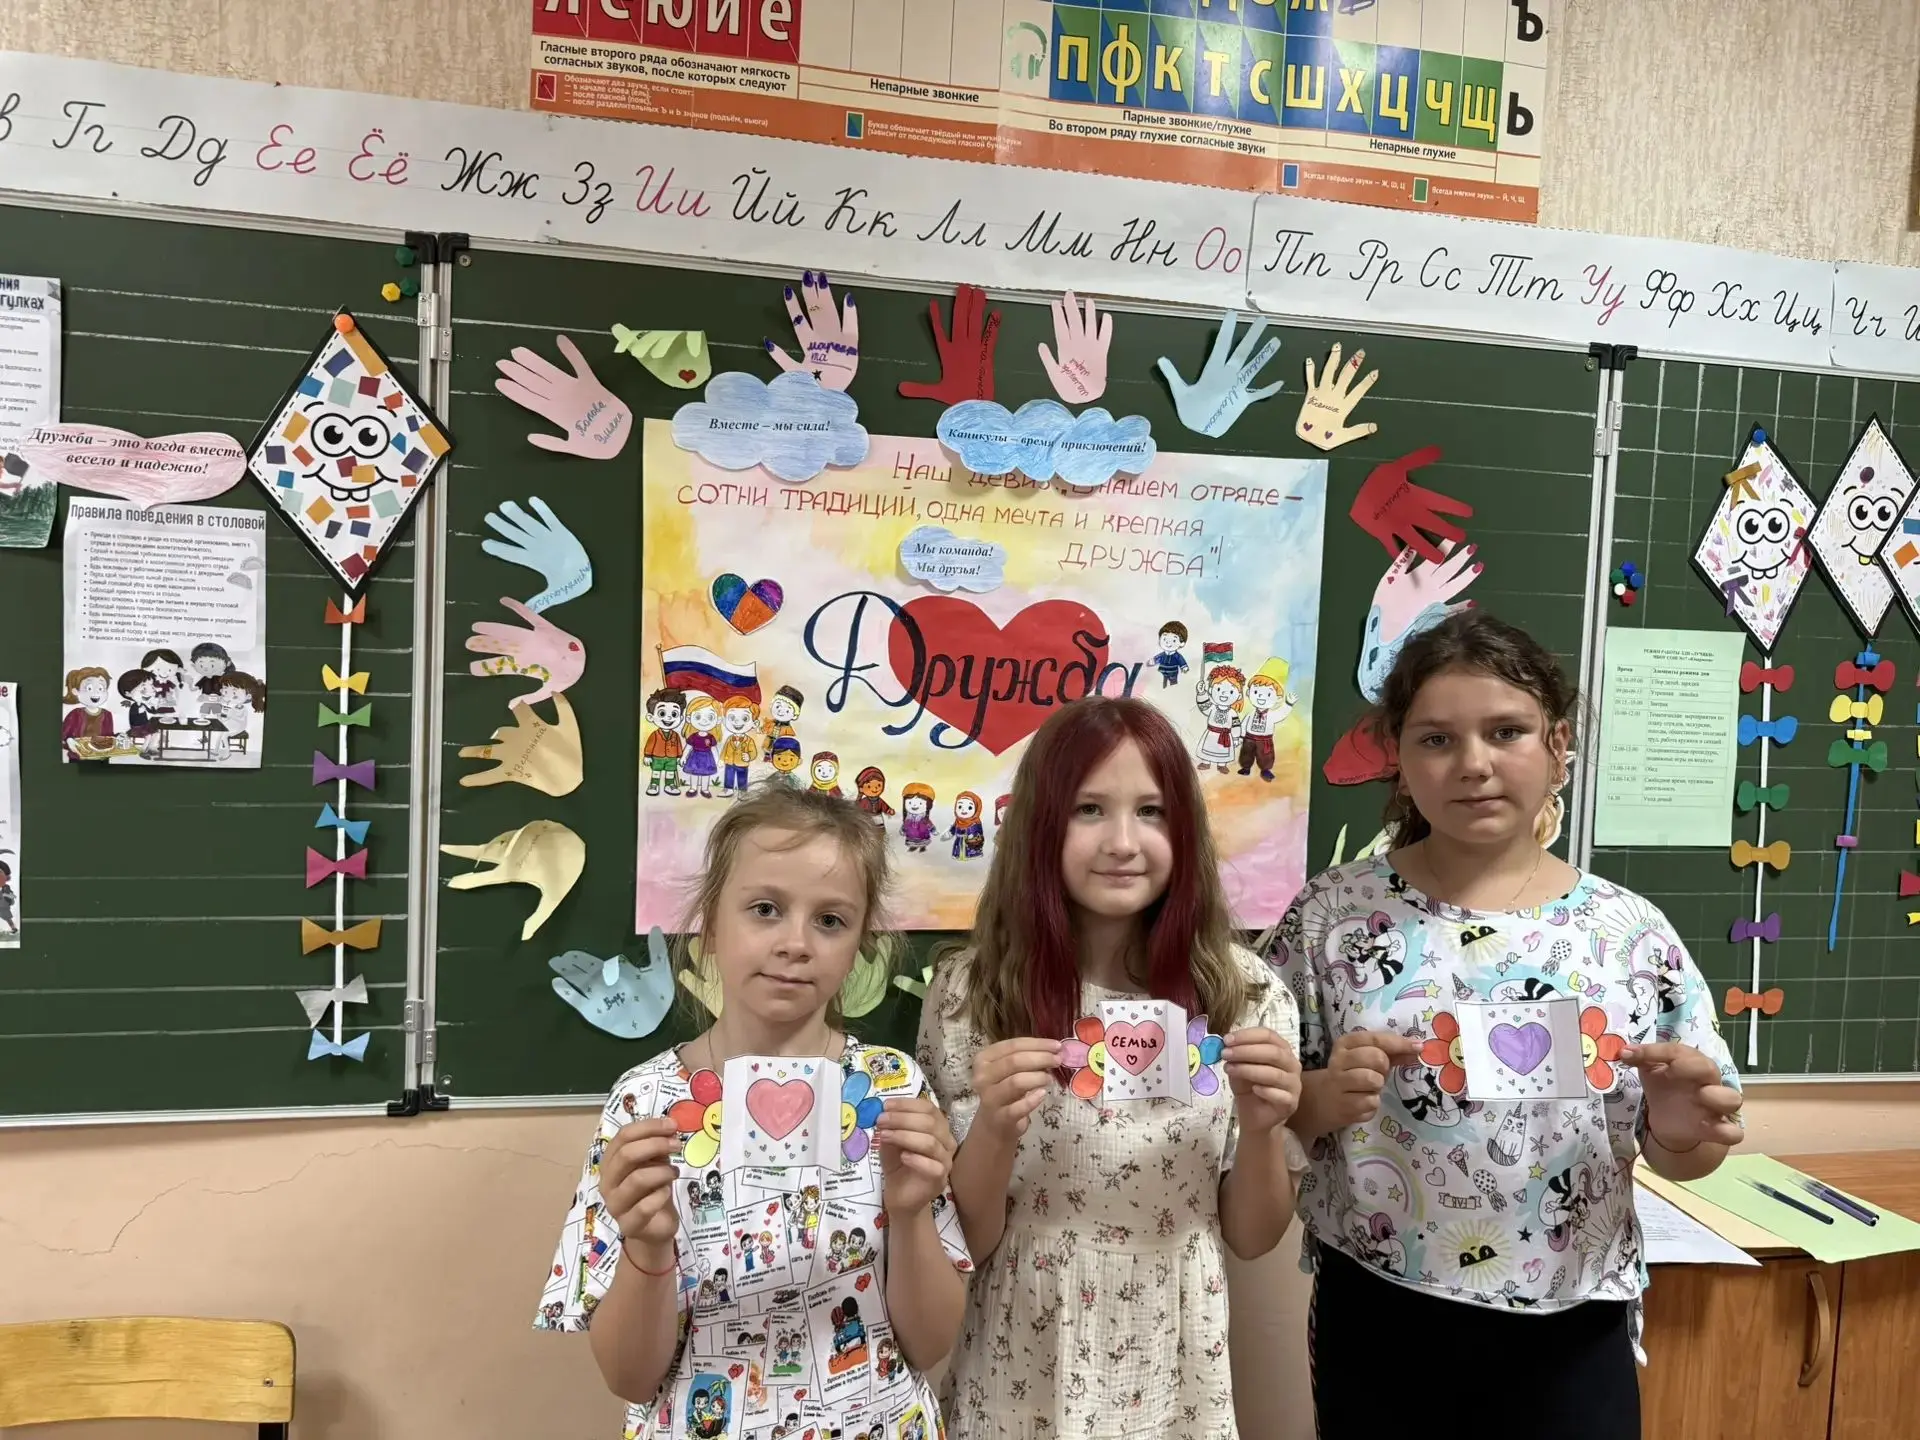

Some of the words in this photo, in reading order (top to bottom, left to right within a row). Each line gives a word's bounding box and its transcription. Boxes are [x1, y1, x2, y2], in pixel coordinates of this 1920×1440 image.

[540, 40, 588, 56] Гласные
[591, 48, 636, 61] второго
[640, 54, 667, 66] ряда
[670, 57, 738, 74] обозначают
[740, 66, 791, 81] мягкость
[544, 55, 603, 69] согласных
[606, 61, 649, 75] звуков,
[651, 68, 685, 79] после
[688, 72, 736, 85] которых
[739, 78, 786, 92] следуют
[564, 75, 609, 85] Обозначают
[651, 85, 670, 93] если
[573, 92, 594, 100] после
[596, 94, 625, 103] гласной
[573, 98, 594, 108] после
[608, 88, 629, 96] слова
[870, 78, 929, 98] Непарные
[932, 89, 979, 103] звонкие
[1123, 111, 1166, 125] Парные
[1169, 116, 1252, 136] звонкие/глухие
[1049, 119, 1063, 131] Во
[1066, 123, 1107, 137] втором
[1110, 127, 1137, 141] ряду
[1140, 130, 1177, 144] глухие
[1180, 134, 1235, 149] согласные
[1237, 142, 1266, 155] звуки
[1369, 138, 1420, 156] Непарные
[1422, 147, 1457, 160] глухие
[52, 100, 113, 154] Гг
[141, 115, 228, 187] Дд
[256, 124, 317, 175] Ее
[348, 127, 410, 186] Ёё
[440, 146, 539, 201] Жж
[561, 161, 615, 224] Зз
[635, 165, 711, 219] Ии
[731, 169, 806, 229] Йй
[823, 187, 898, 238] Кк
[915, 199, 987, 249] Лл
[1004, 209, 1094, 260] Мм
[1109, 217, 1178, 268] Нн
[1195, 226, 1243, 275] Оо
[1263, 229, 1332, 278] Пп
[1348, 239, 1404, 302] Рр
[1418, 248, 1462, 291] Сс
[1477, 252, 1564, 302] Тт
[1579, 263, 1625, 326] Уу
[1640, 268, 1695, 329] Фф
[1706, 281, 1761, 324] Хх
[1772, 289, 1824, 336] Цц
[1844, 296, 1888, 338] Чч
[708, 418, 759, 432] Вместе
[772, 421, 793, 432] мы
[796, 419, 831, 432] сила!
[28, 427, 93, 446] Дружба
[110, 438, 140, 450] это
[144, 441, 185, 455] когда
[189, 445, 245, 459] вместе
[948, 427, 1007, 444] Каникулы
[1021, 435, 1055, 449] время
[1060, 437, 1147, 455] приключений!
[66, 454, 116, 467] весело
[120, 459, 129, 467] и
[134, 460, 208, 475] надежно!
[677, 484, 768, 506] СОТНИ
[780, 487, 921, 521] ТРАДИЦИЙ,
[927, 500, 985, 523] ОДНА
[71, 504, 122, 521] Правила
[126, 507, 193, 525] поведения
[197, 513, 205, 525] в
[208, 514, 266, 530] столовой
[914, 543, 937, 556] Мы
[938, 543, 994, 558] команда!
[915, 561, 938, 575] Мы
[939, 562, 981, 577] друзья!
[802, 590, 1144, 748] Дружба
[512, 727, 548, 779] Вероника
[1111, 1035, 1157, 1048] СЕМЬЯ
